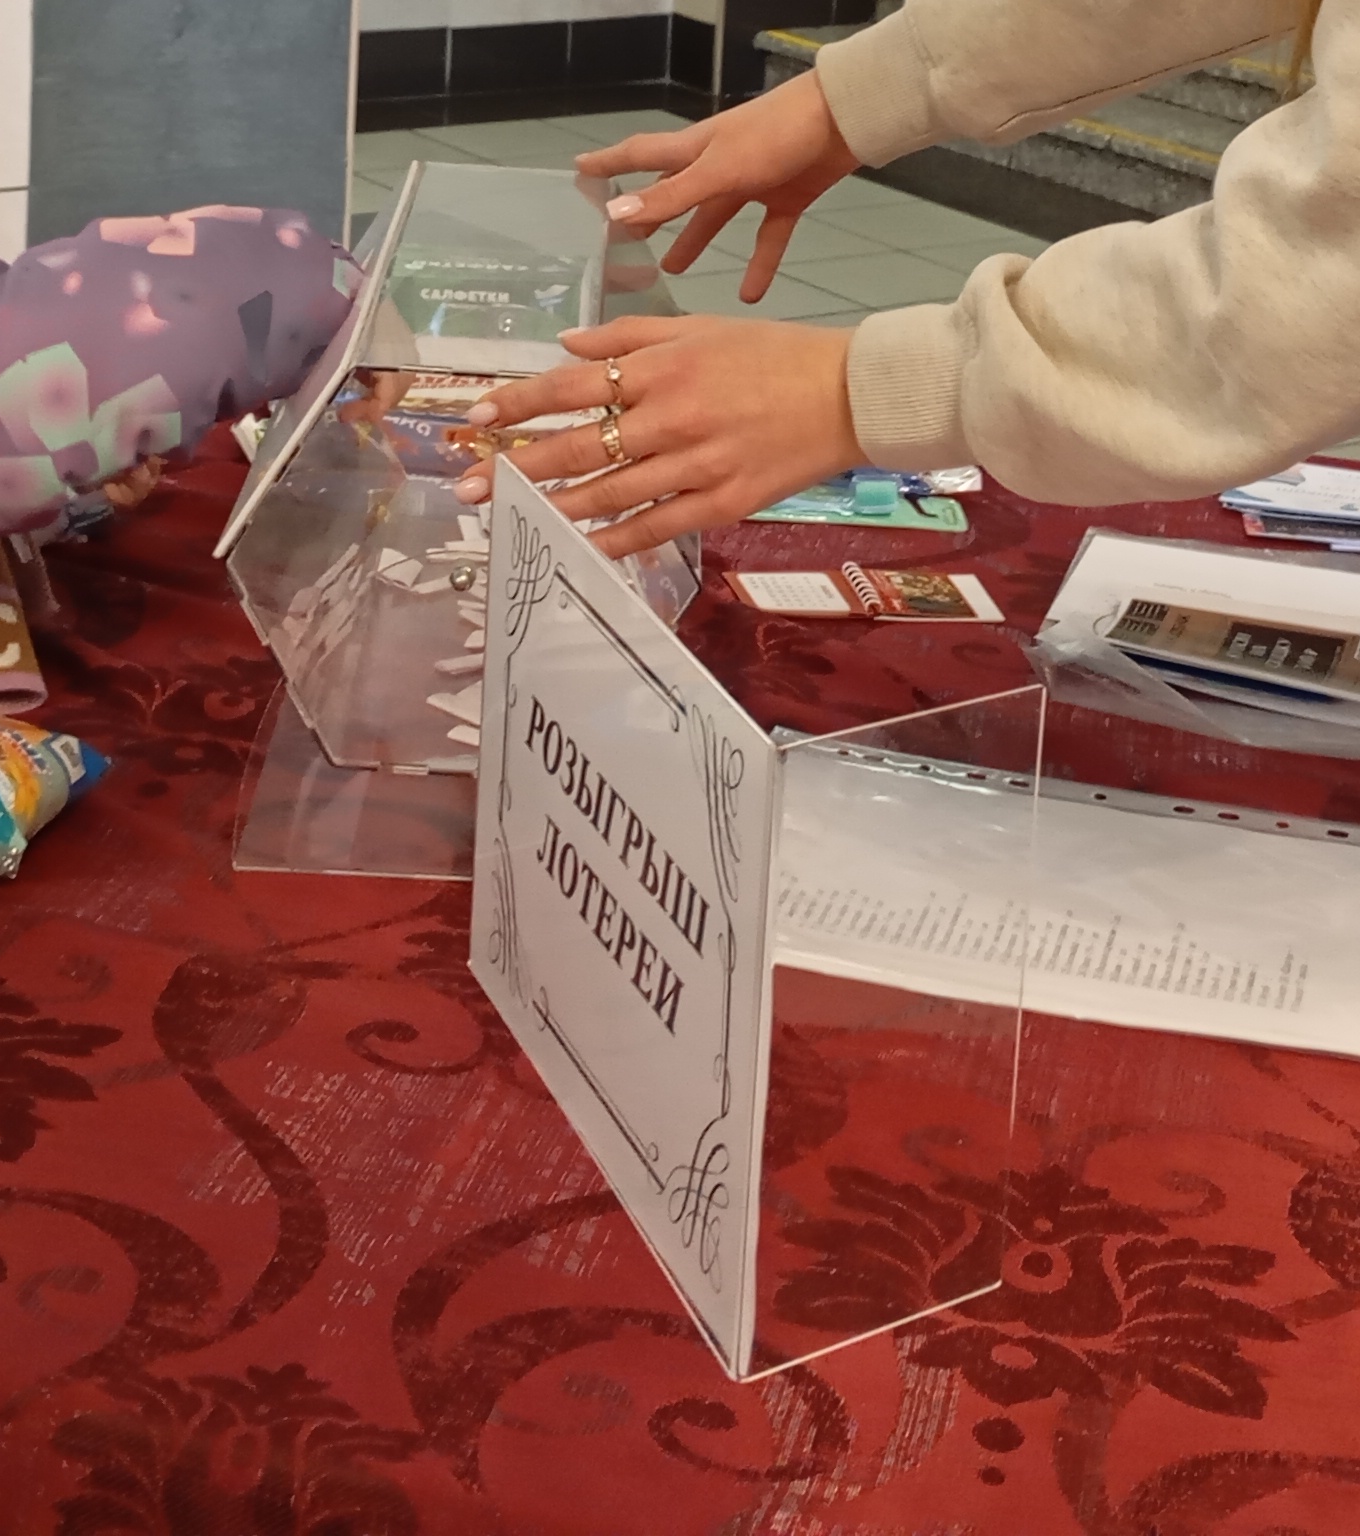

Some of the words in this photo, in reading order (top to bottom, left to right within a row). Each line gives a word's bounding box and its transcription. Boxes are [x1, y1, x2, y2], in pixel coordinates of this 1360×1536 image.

[419, 287, 510, 304] САЛФЕТКИ
[524, 694, 710, 960] РОЗЫГРЫШ
[536, 814, 685, 1038] ЛОТЕРЕИ
